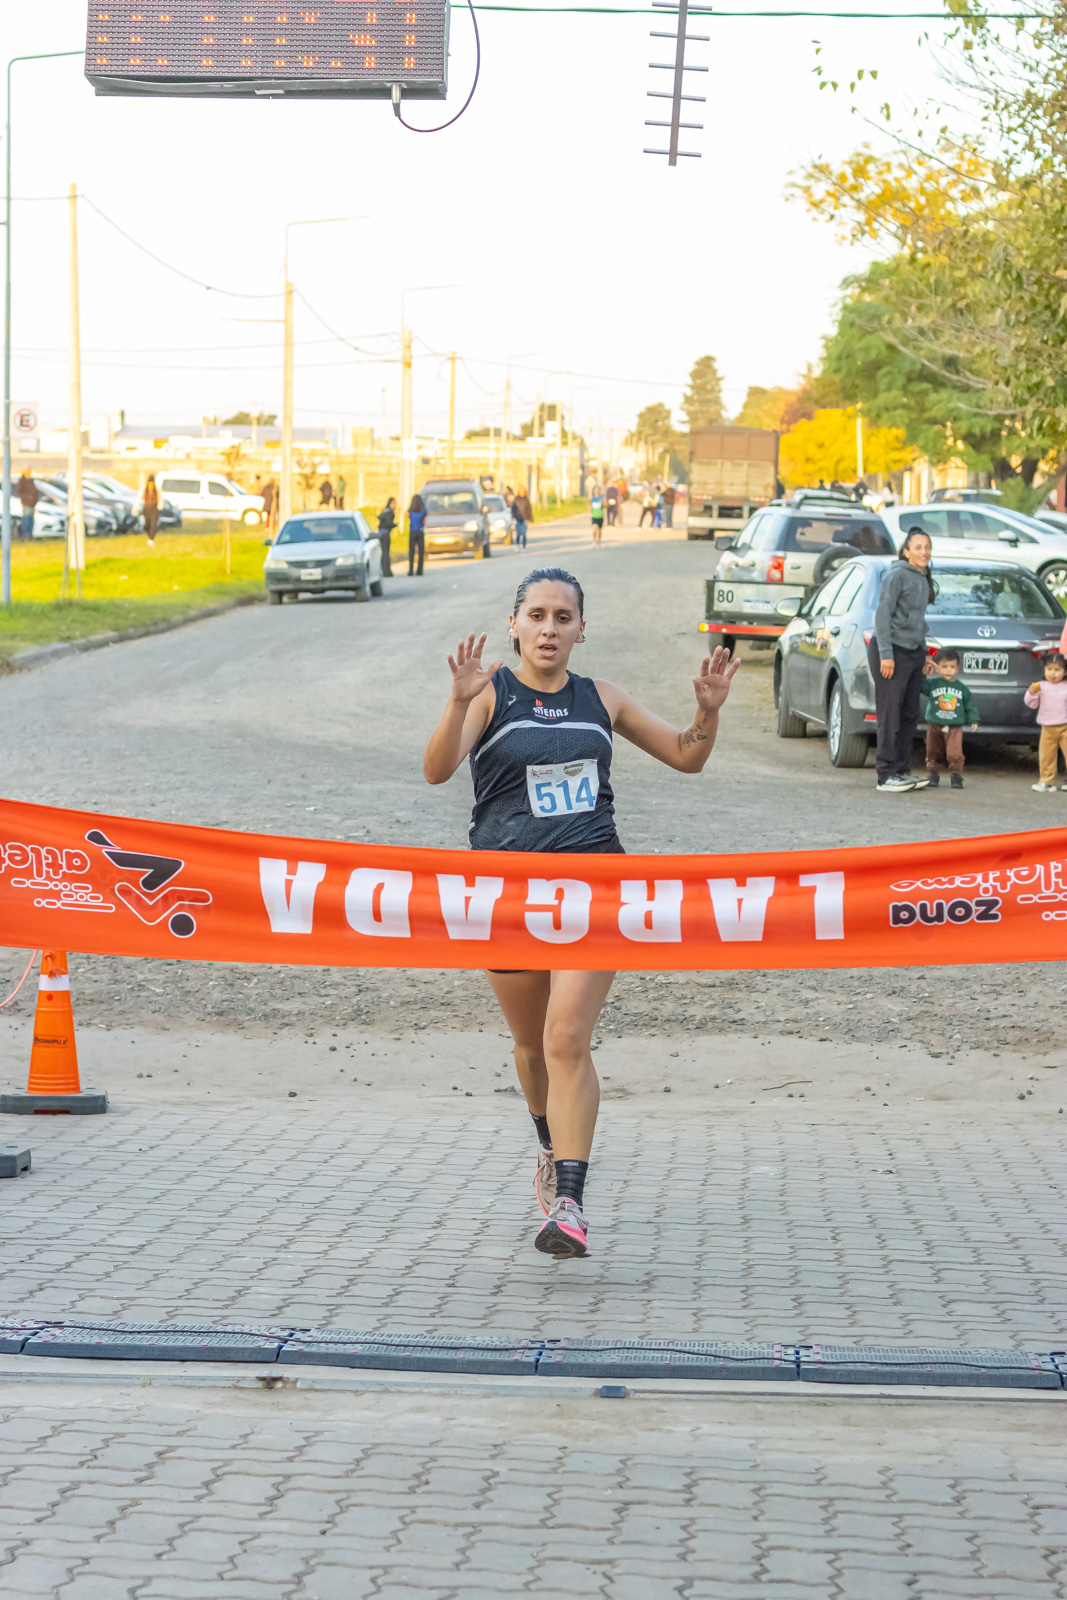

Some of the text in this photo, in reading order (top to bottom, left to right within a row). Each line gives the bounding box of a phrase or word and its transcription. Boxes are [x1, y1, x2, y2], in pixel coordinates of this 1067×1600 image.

[716, 589, 734, 603] 80
[988, 657, 1007, 670] 477
[535, 776, 596, 814] 514
[258, 857, 846, 943] LARGADA
[889, 897, 1003, 927] zona
